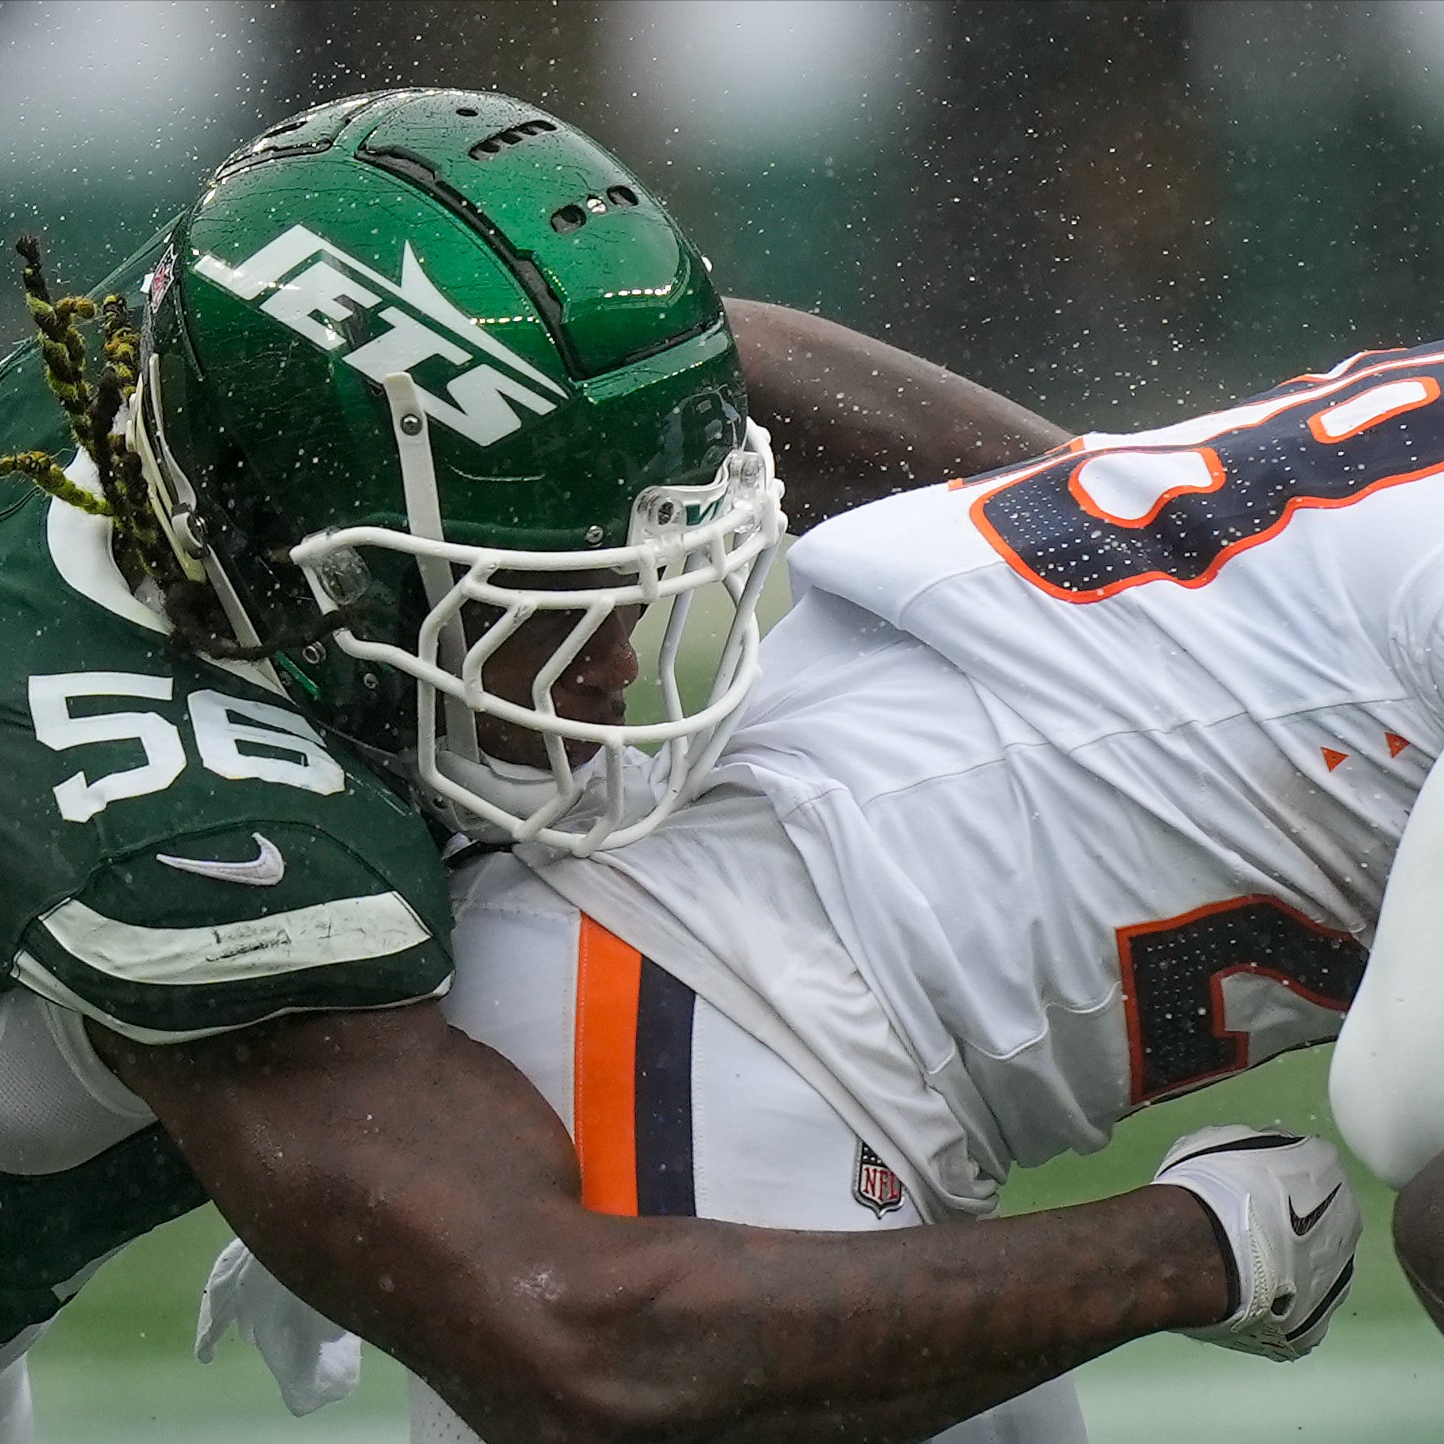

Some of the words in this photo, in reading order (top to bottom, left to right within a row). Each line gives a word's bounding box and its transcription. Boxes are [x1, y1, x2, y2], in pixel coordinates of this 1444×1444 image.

[194, 224, 569, 446] JETS
[29, 671, 346, 824] 56
[863, 1167, 899, 1202] NFL
